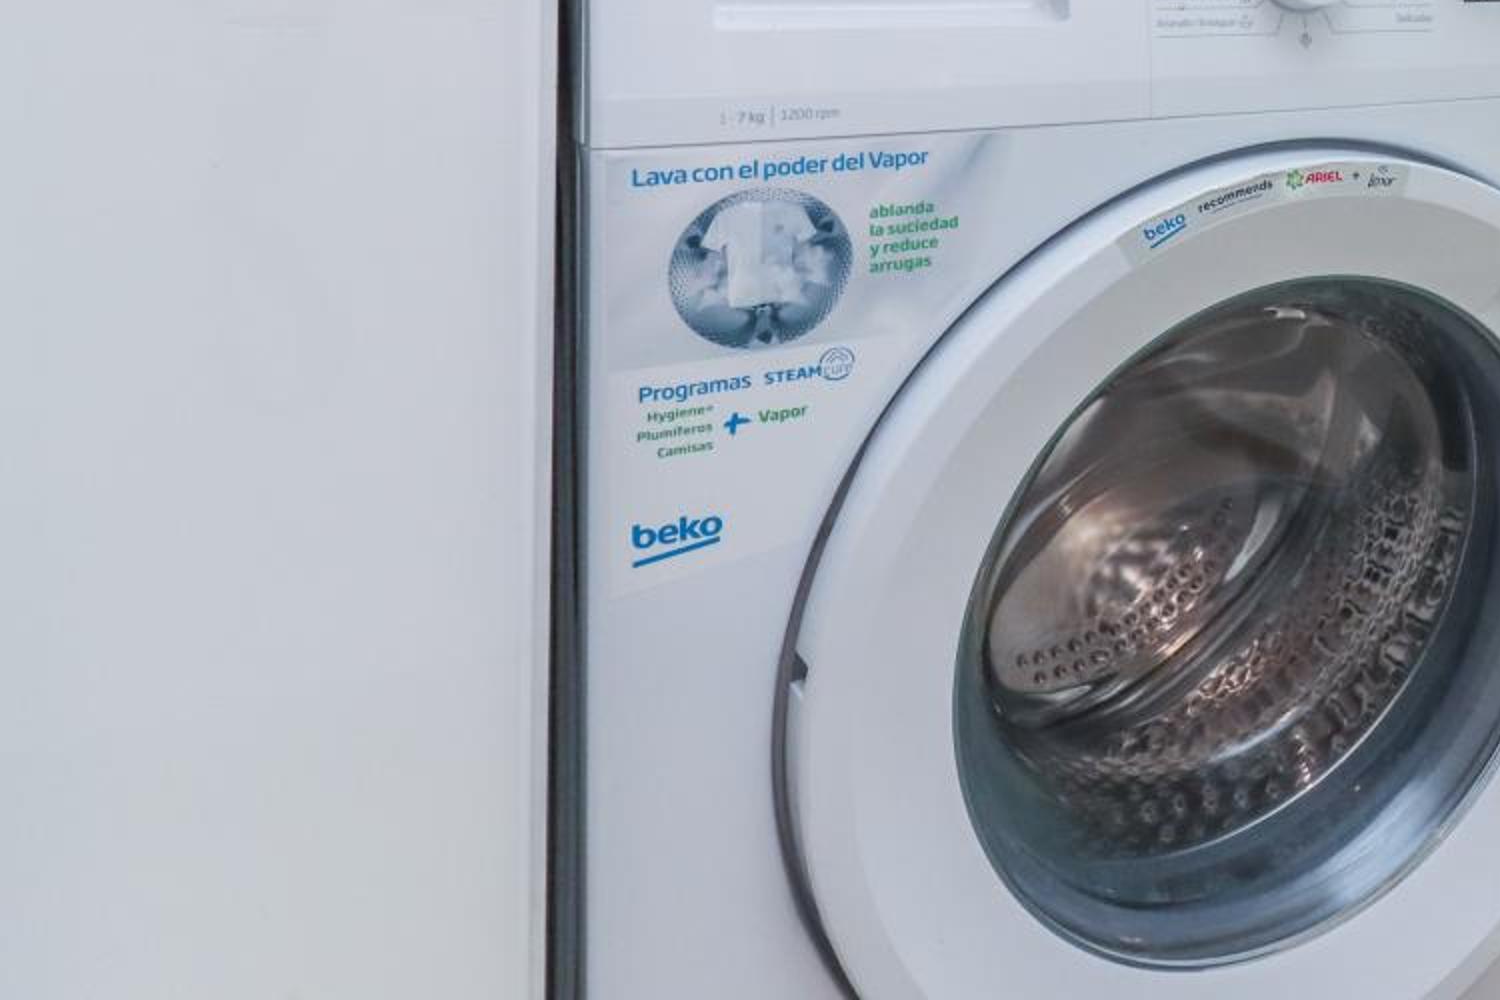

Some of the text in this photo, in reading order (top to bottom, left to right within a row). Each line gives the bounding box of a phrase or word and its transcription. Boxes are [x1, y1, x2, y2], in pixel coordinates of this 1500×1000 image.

[631, 150, 929, 188] Lava con el poder del Vapor
[869, 200, 936, 219] ablanda
[1143, 212, 1186, 241] beko
[1197, 179, 1274, 214] recommends
[1305, 170, 1344, 185] ARIEL
[869, 215, 960, 237] la suciedad
[869, 236, 940, 257] y reduce
[869, 255, 932, 275] arrugas
[638, 374, 752, 404] Programas
[764, 363, 822, 386] STEAM
[758, 404, 809, 425] Vapor
[656, 439, 715, 460] Camisas
[631, 514, 724, 550] beko
